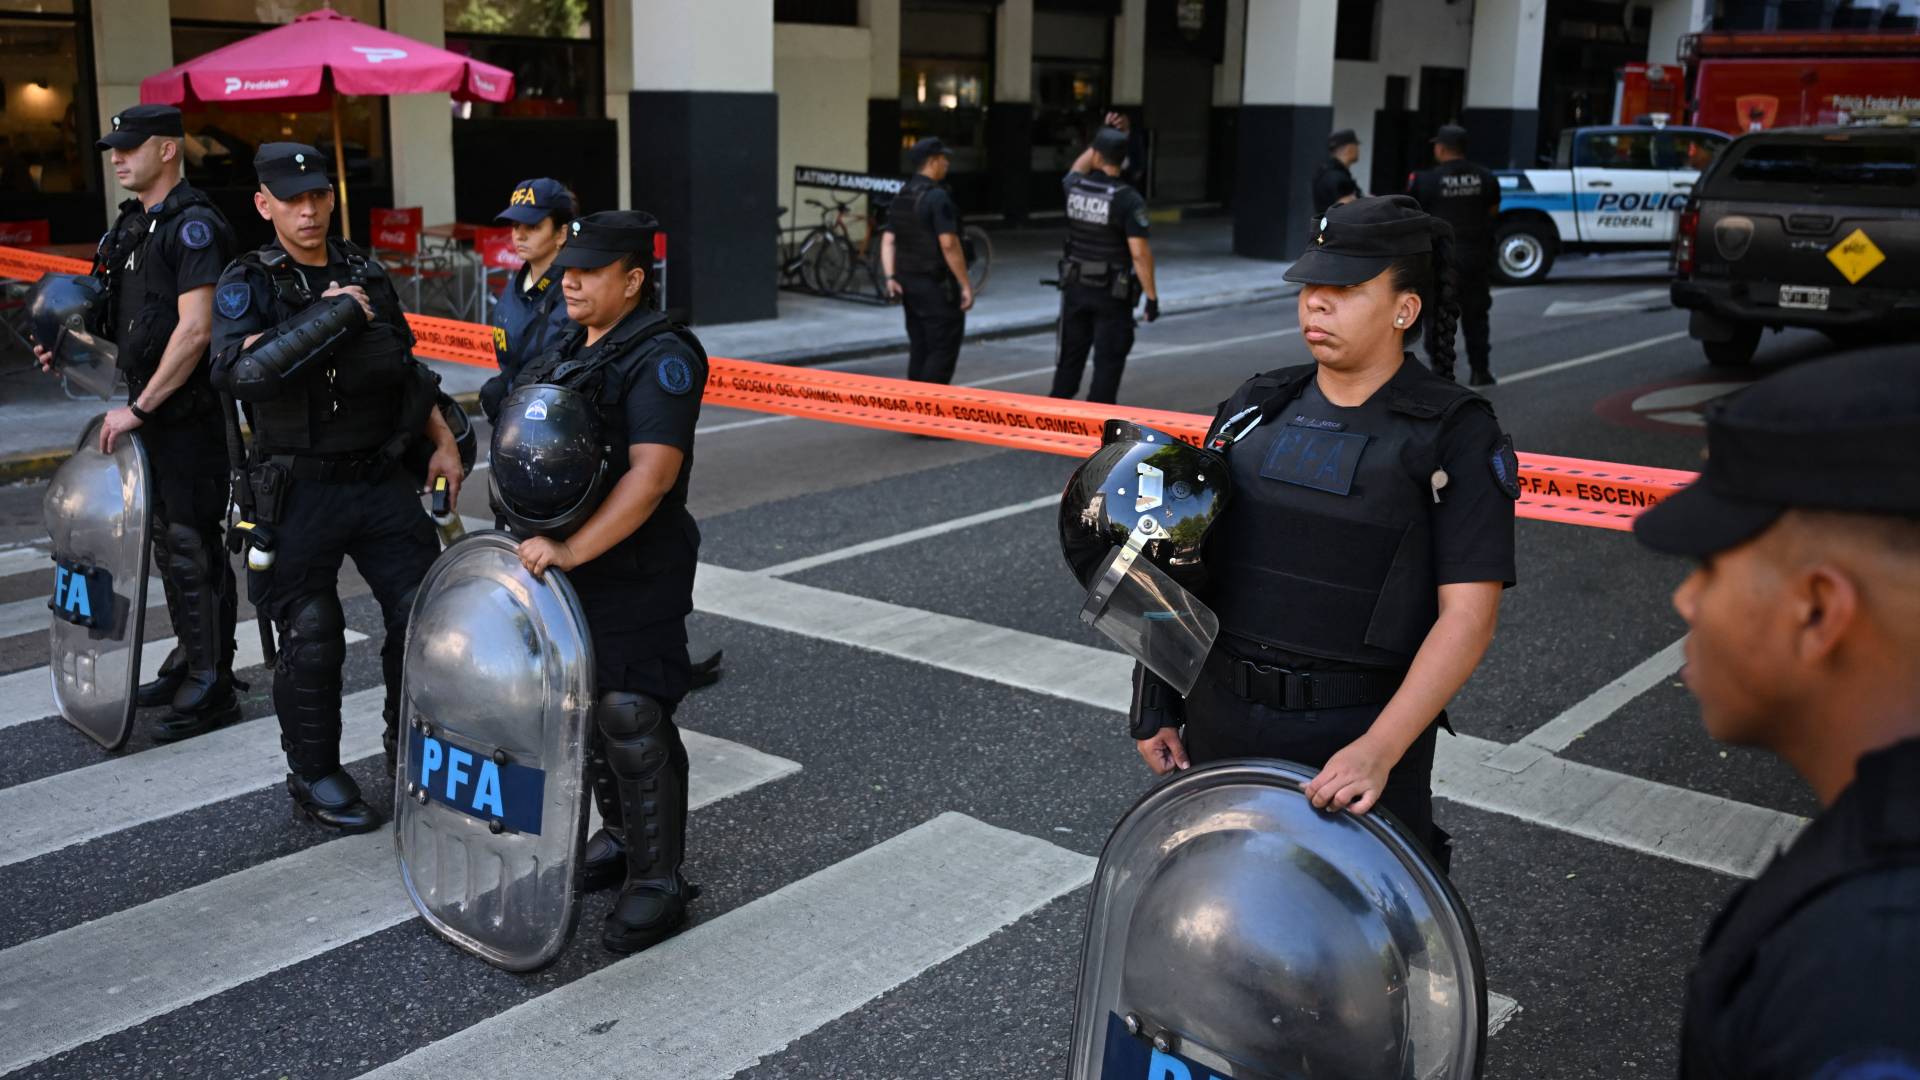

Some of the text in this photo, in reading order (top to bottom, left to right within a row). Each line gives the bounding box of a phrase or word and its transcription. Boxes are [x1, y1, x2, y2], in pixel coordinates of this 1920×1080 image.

[796, 169, 838, 186] LATINO
[511, 187, 536, 206] PFA
[1599, 193, 1689, 212] POLIC
[1598, 215, 1654, 228] FEDERAL
[428, 332, 443, 345] DEL
[444, 334, 476, 350] CRIMEN
[480, 340, 494, 354] NO
[733, 377, 775, 394] ESCENA
[776, 383, 800, 398] DEL
[801, 387, 844, 404] CRIMEN
[850, 394, 868, 407] NO
[869, 396, 911, 413] PASAR
[952, 406, 1004, 426] ESCENA
[1007, 413, 1032, 429] DEL
[1035, 416, 1089, 437] CRIMEN
[1269, 433, 1345, 483] PFA
[421, 736, 504, 817] PFA
